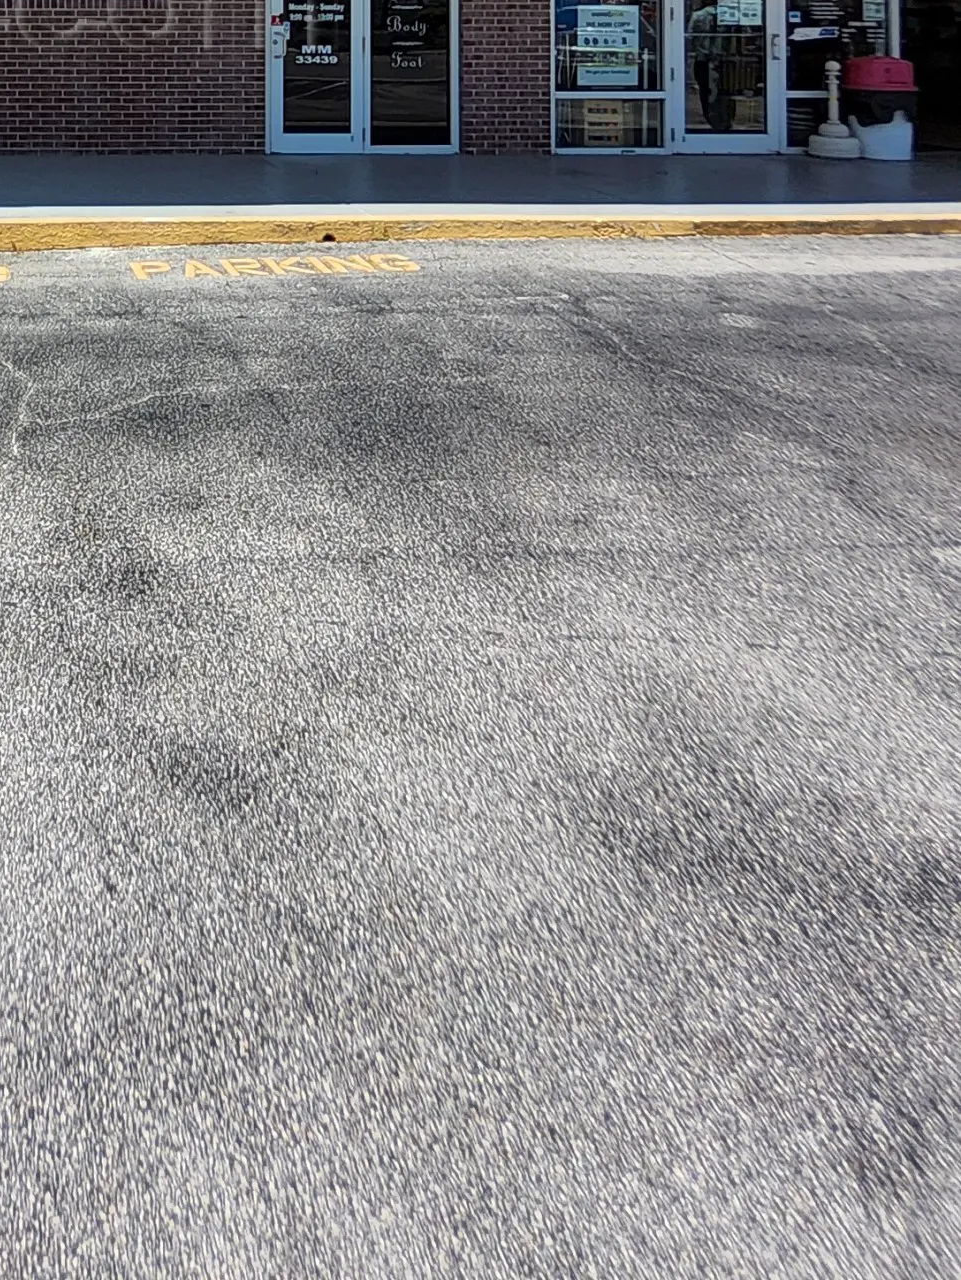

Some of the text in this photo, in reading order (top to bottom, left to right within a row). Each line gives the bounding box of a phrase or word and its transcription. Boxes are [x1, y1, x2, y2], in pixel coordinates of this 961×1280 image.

[288, 2, 315, 13] Monday
[319, 2, 345, 13] Sunday
[386, 15, 428, 36] Body
[295, 55, 338, 64] 33439
[391, 51, 425, 68] Foot
[129, 253, 422, 280] PARKING
